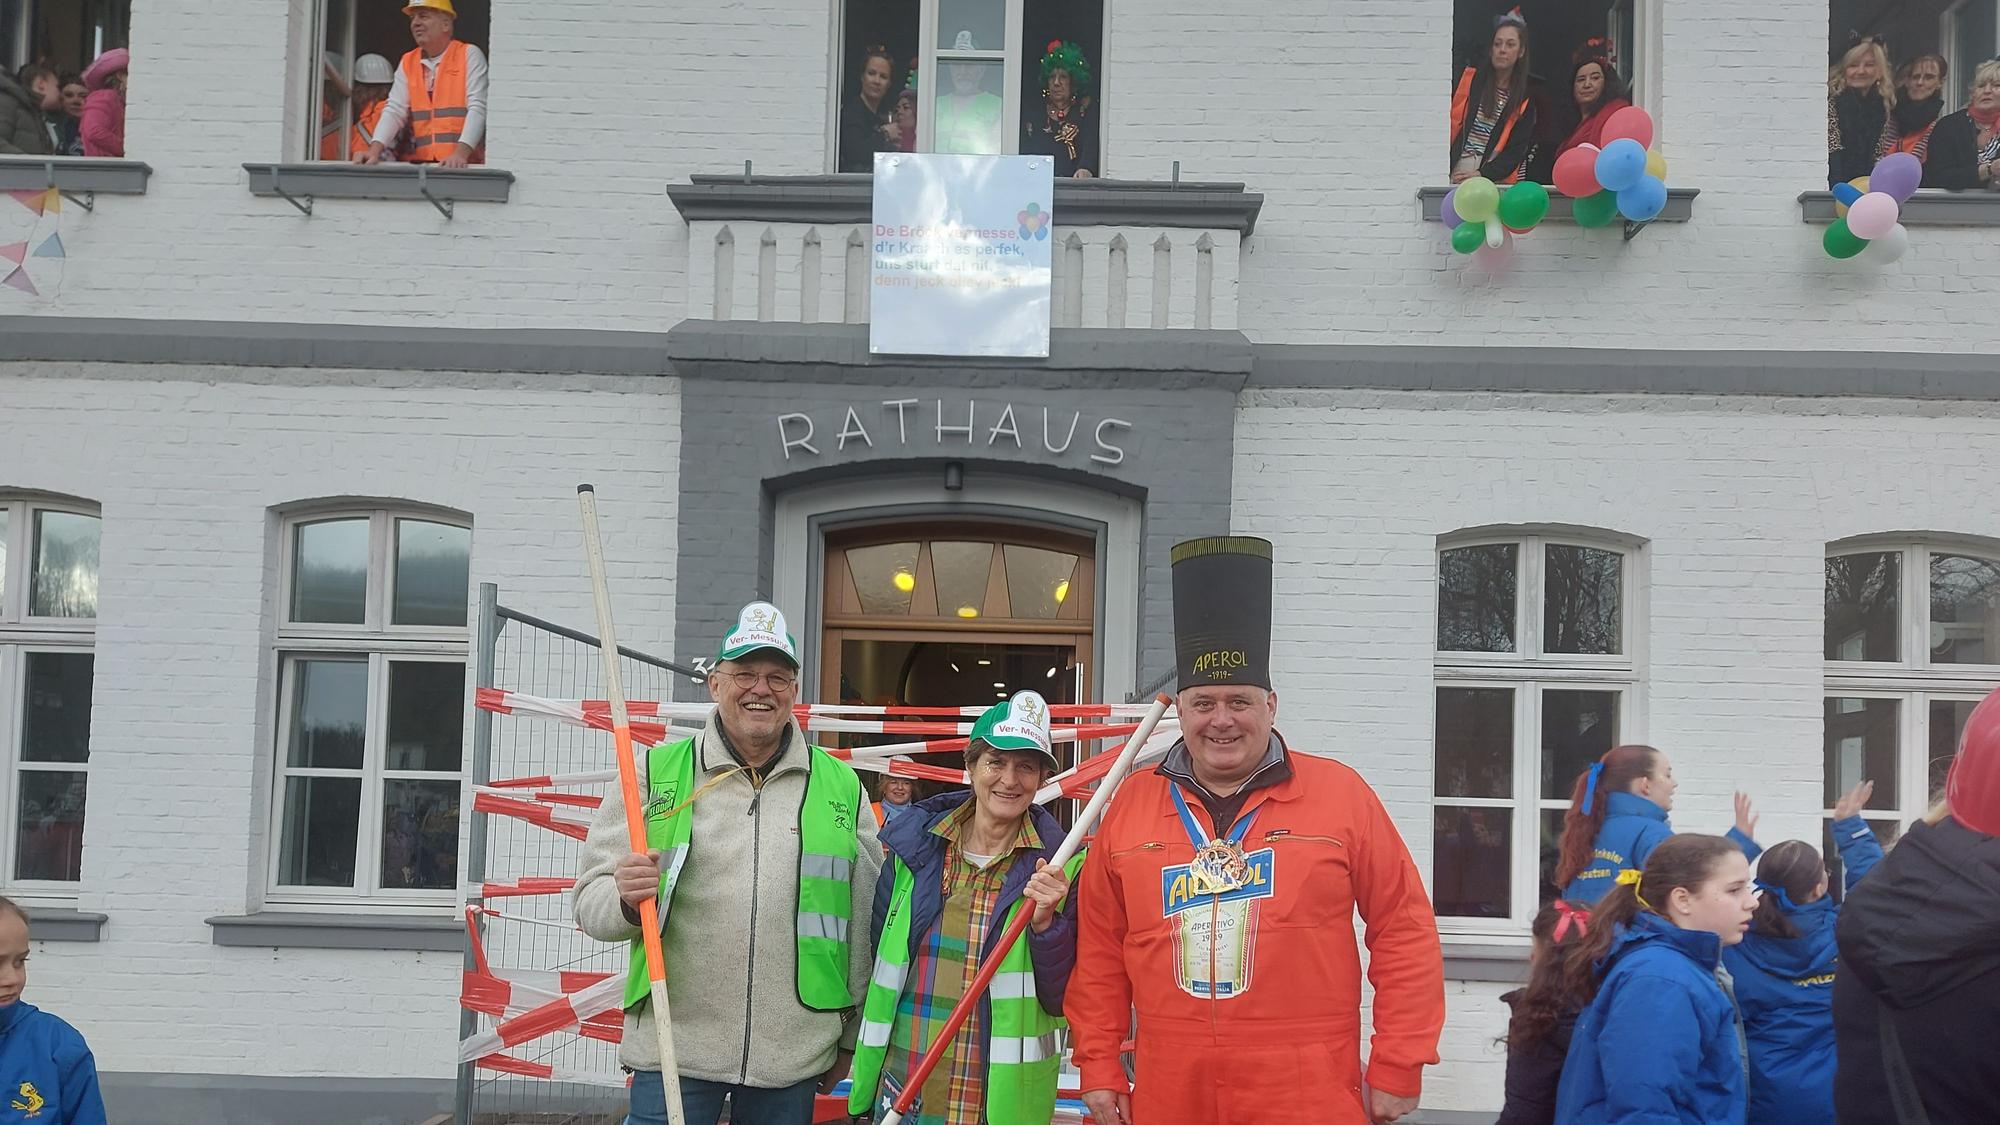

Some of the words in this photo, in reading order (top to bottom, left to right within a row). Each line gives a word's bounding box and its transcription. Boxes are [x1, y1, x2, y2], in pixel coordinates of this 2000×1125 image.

[875, 225, 895, 237] De
[875, 241, 895, 254] d'r
[954, 245, 971, 256] es
[975, 243, 1025, 257] perfek,
[777, 398, 1132, 465] RATHAUS
[730, 636, 749, 645] Ver-
[750, 633, 789, 650] Messung
[691, 657, 717, 684] 3
[1192, 651, 1248, 675] APEROL
[998, 724, 1019, 733] Ver-
[1191, 918, 1235, 932] APERTIVO
